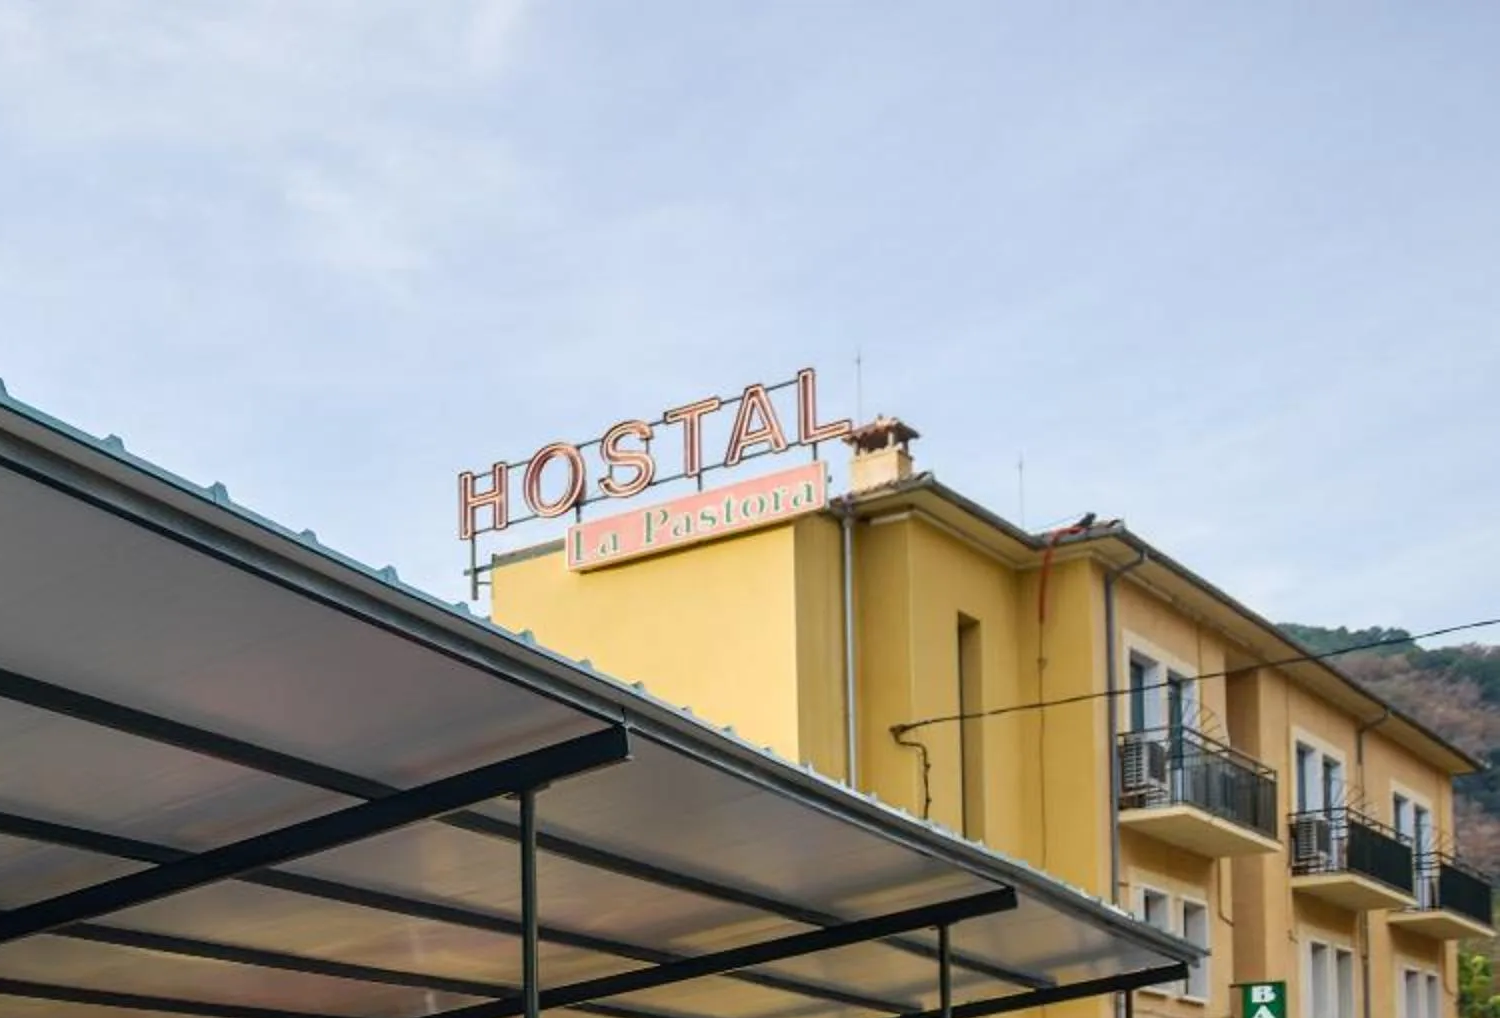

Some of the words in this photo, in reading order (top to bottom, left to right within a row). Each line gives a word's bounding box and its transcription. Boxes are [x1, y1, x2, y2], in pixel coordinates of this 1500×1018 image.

[459, 367, 852, 540] HOSTAL
[573, 528, 621, 562] La
[643, 481, 816, 545] Pastora
